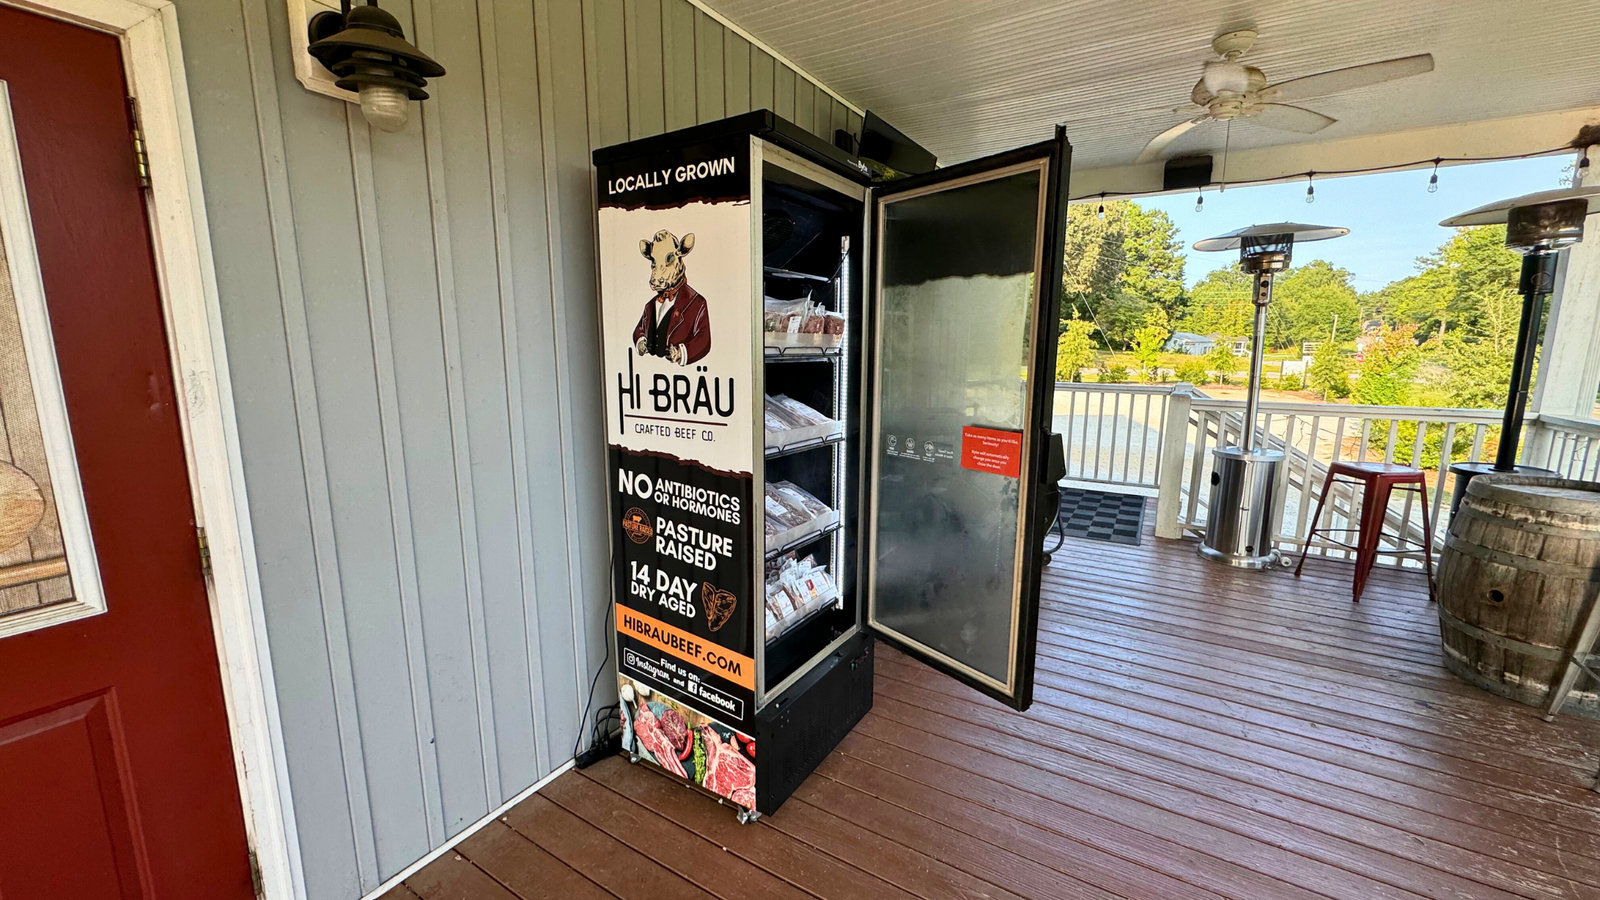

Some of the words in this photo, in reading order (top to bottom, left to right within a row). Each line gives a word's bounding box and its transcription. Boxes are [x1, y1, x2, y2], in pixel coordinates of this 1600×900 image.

[608, 168, 672, 195] LOCALLY
[675, 156, 735, 183] GROWN
[618, 347, 641, 435] HI
[648, 365, 734, 417] BRÄU
[635, 423, 670, 437] CRAFTED
[674, 427, 696, 440] BEEF
[702, 430, 716, 442] CO.
[618, 468, 653, 500] NO
[655, 478, 740, 512] ANTIBIOTICS
[654, 492, 670, 506] OR
[672, 496, 741, 525] HORMONES
[655, 535, 717, 571] RAISED
[656, 516, 733, 558] PASTURE
[630, 560, 650, 586] 14
[656, 568, 698, 602] DAY
[630, 580, 656, 602] DRY
[658, 593, 696, 618] AGED
[624, 614, 742, 677] HIBRAUBEEF.COM
[660, 658, 676, 672] Find
[678, 668, 686, 677] us
[688, 672, 700, 683] on:
[673, 678, 685, 687] and
[699, 686, 736, 712] facebook
